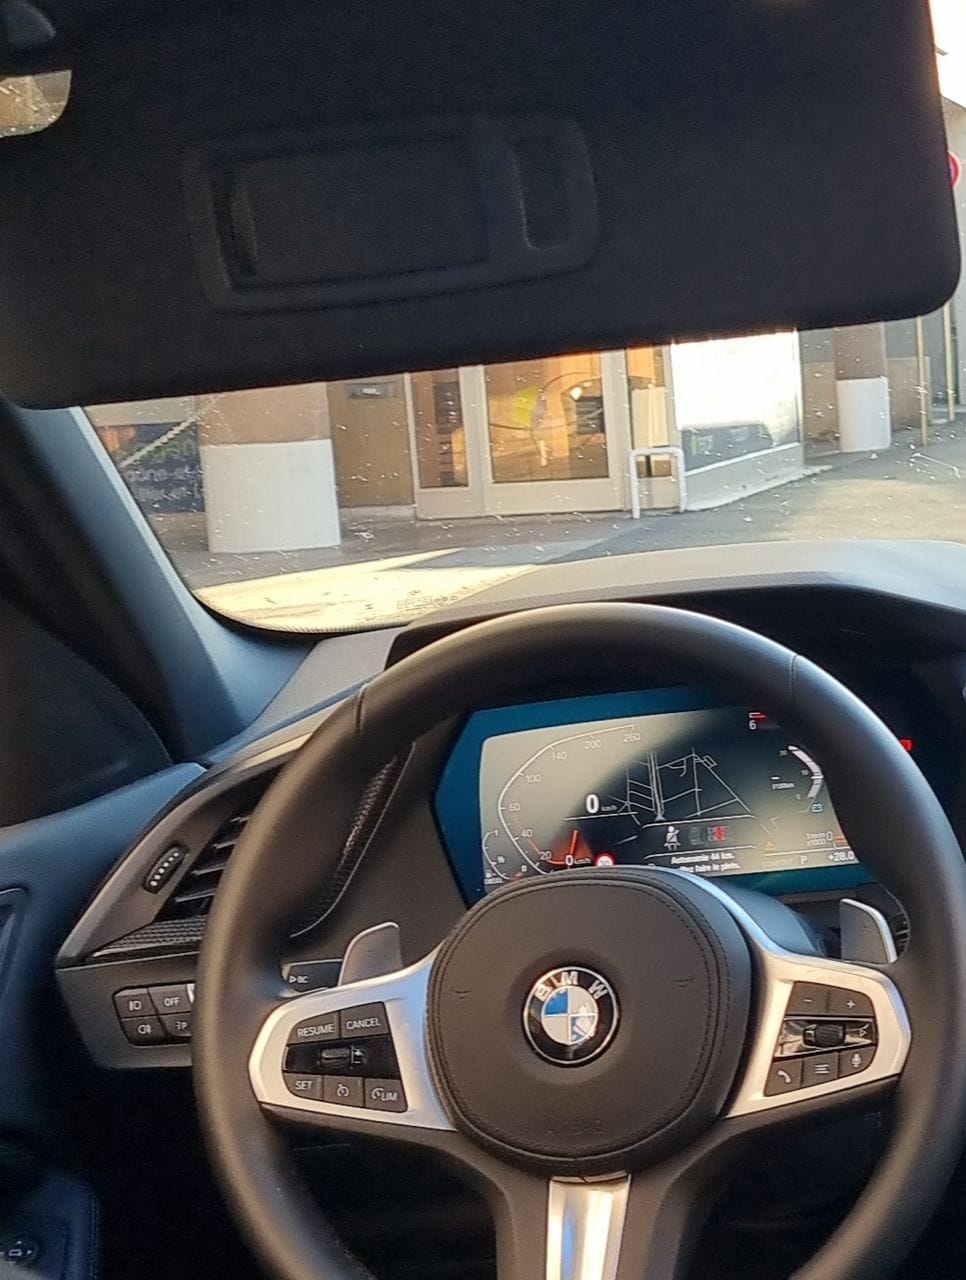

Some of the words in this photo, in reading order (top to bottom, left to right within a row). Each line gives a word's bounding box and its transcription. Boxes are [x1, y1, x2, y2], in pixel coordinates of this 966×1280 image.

[748, 720, 757, 730] 6
[623, 732, 641, 743] 260
[585, 740, 601, 749] 200
[552, 751, 566, 760] 140
[526, 774, 541, 783] 100
[585, 793, 599, 814] 0
[521, 829, 533, 838] 40
[826, 831, 834, 841] 0
[540, 851, 552, 860] 20
[565, 854, 574, 866] 0
[710, 852, 720, 860] 44
[800, 855, 808, 865] P
[828, 850, 855, 862] +28.0
[534, 970, 609, 1003] BMW
[163, 997, 180, 1007] OFF
[346, 1017, 381, 1030] CANCEL
[297, 1023, 335, 1037] RESUME
[295, 1080, 313, 1090] SET
[382, 1091, 398, 1102] LIM
